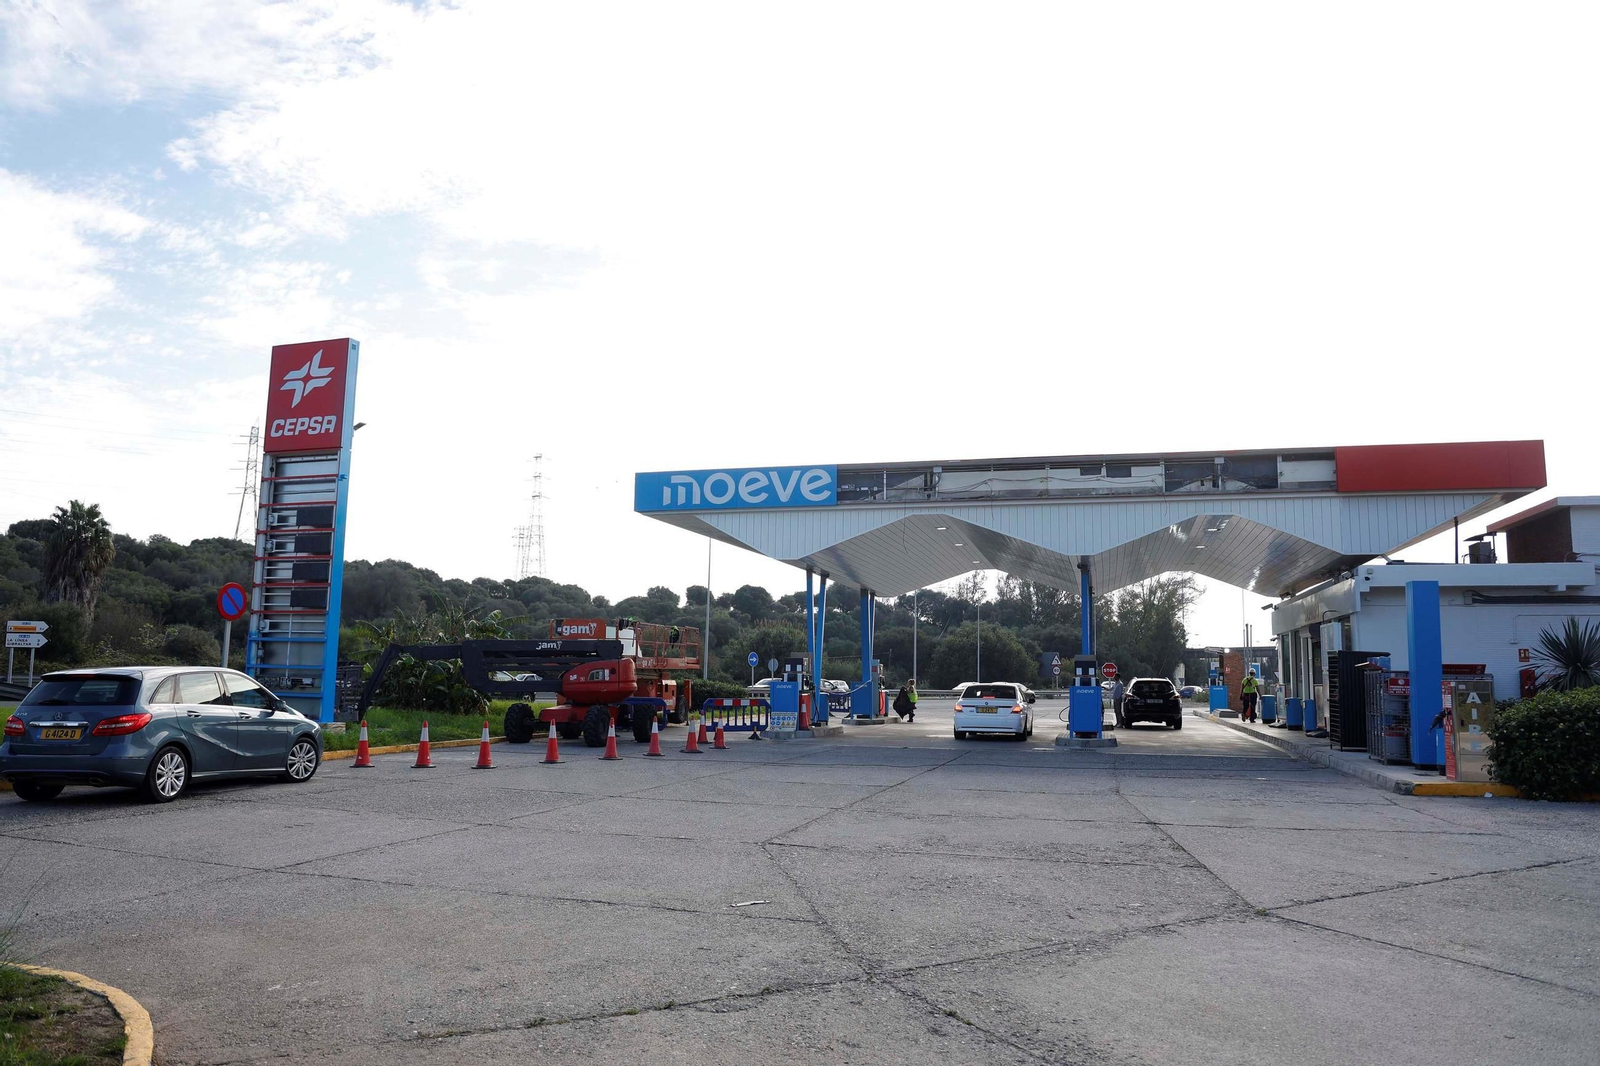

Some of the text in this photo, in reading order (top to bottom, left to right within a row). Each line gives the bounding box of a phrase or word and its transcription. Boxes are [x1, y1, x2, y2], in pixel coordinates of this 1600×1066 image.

[270, 415, 337, 438] CEPSA
[662, 468, 832, 506] moeve
[45, 729, 50, 738] G
[51, 729, 69, 738] 4124
